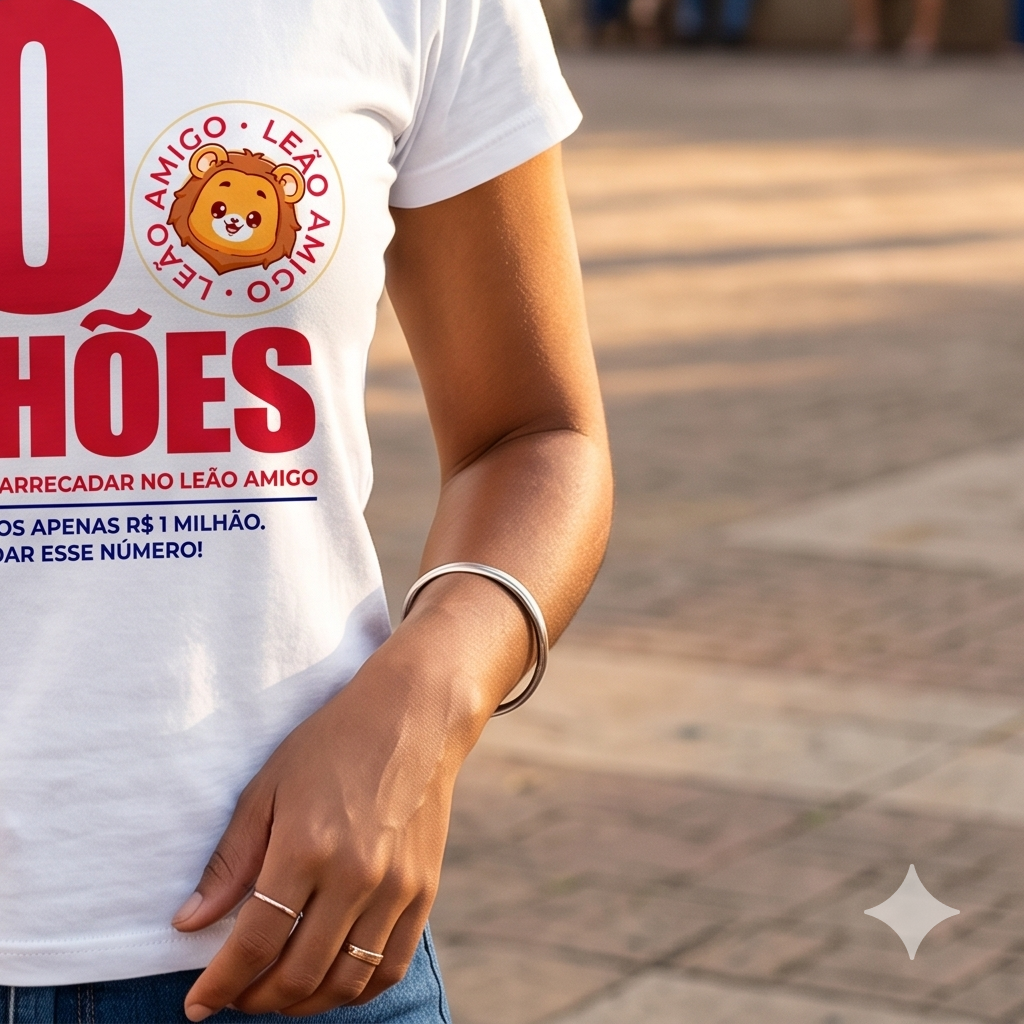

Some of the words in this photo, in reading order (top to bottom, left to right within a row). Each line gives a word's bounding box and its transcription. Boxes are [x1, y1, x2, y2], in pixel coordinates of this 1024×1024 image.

[144, 115, 227, 211] AMIGO
[262, 119, 329, 197] LEÃO
[146, 223, 214, 301] LEÃO
[246, 209, 331, 304] AMIGO
[141, 472, 174, 491] NO
[180, 467, 238, 490] LEÃO
[244, 469, 319, 488] AMIGO
[30, 516, 121, 536] APENAS
[126, 514, 154, 535] R$
[159, 516, 167, 532] 1
[174, 509, 266, 532] MILHÃO.
[41, 544, 94, 562] ESSE
[101, 539, 203, 561] NÚMERO!
